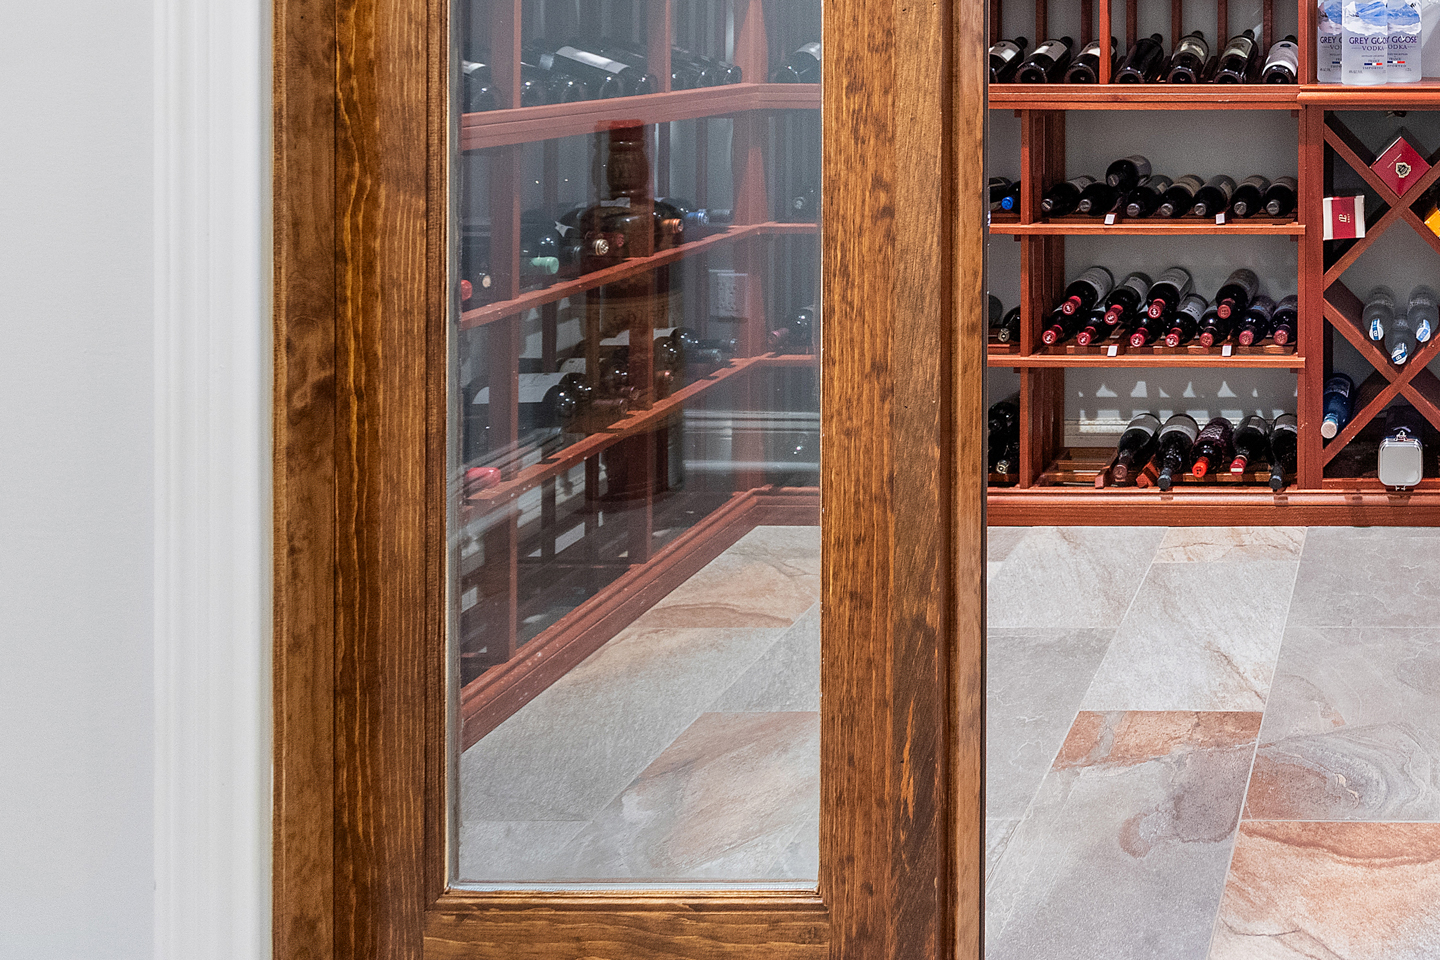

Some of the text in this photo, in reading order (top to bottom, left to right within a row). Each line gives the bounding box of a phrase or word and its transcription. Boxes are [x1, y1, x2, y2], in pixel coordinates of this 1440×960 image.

[1320, 36, 1337, 44] GREY
[1348, 36, 1369, 44] GREY
[1391, 36, 1417, 44] GOOSE
